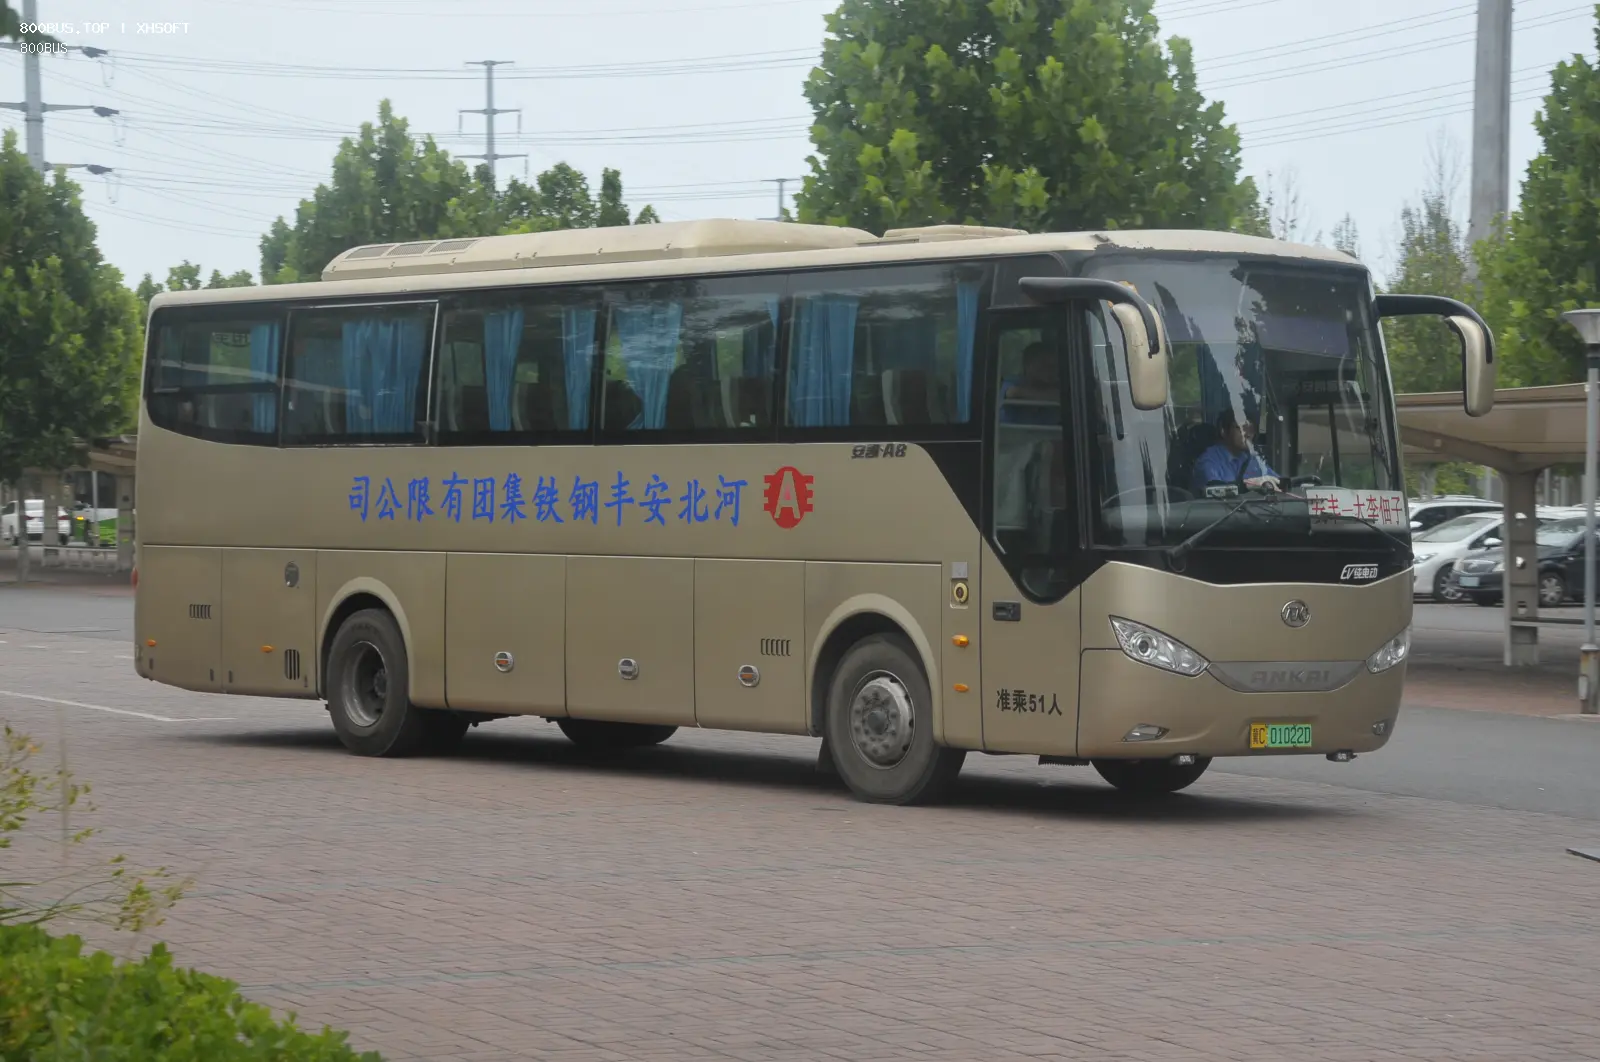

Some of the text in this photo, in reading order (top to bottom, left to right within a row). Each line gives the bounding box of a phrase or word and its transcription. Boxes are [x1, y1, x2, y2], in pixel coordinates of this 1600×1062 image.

[1251, 670, 1330, 685] ANKAI
[996, 688, 1063, 716] 准乘51人
